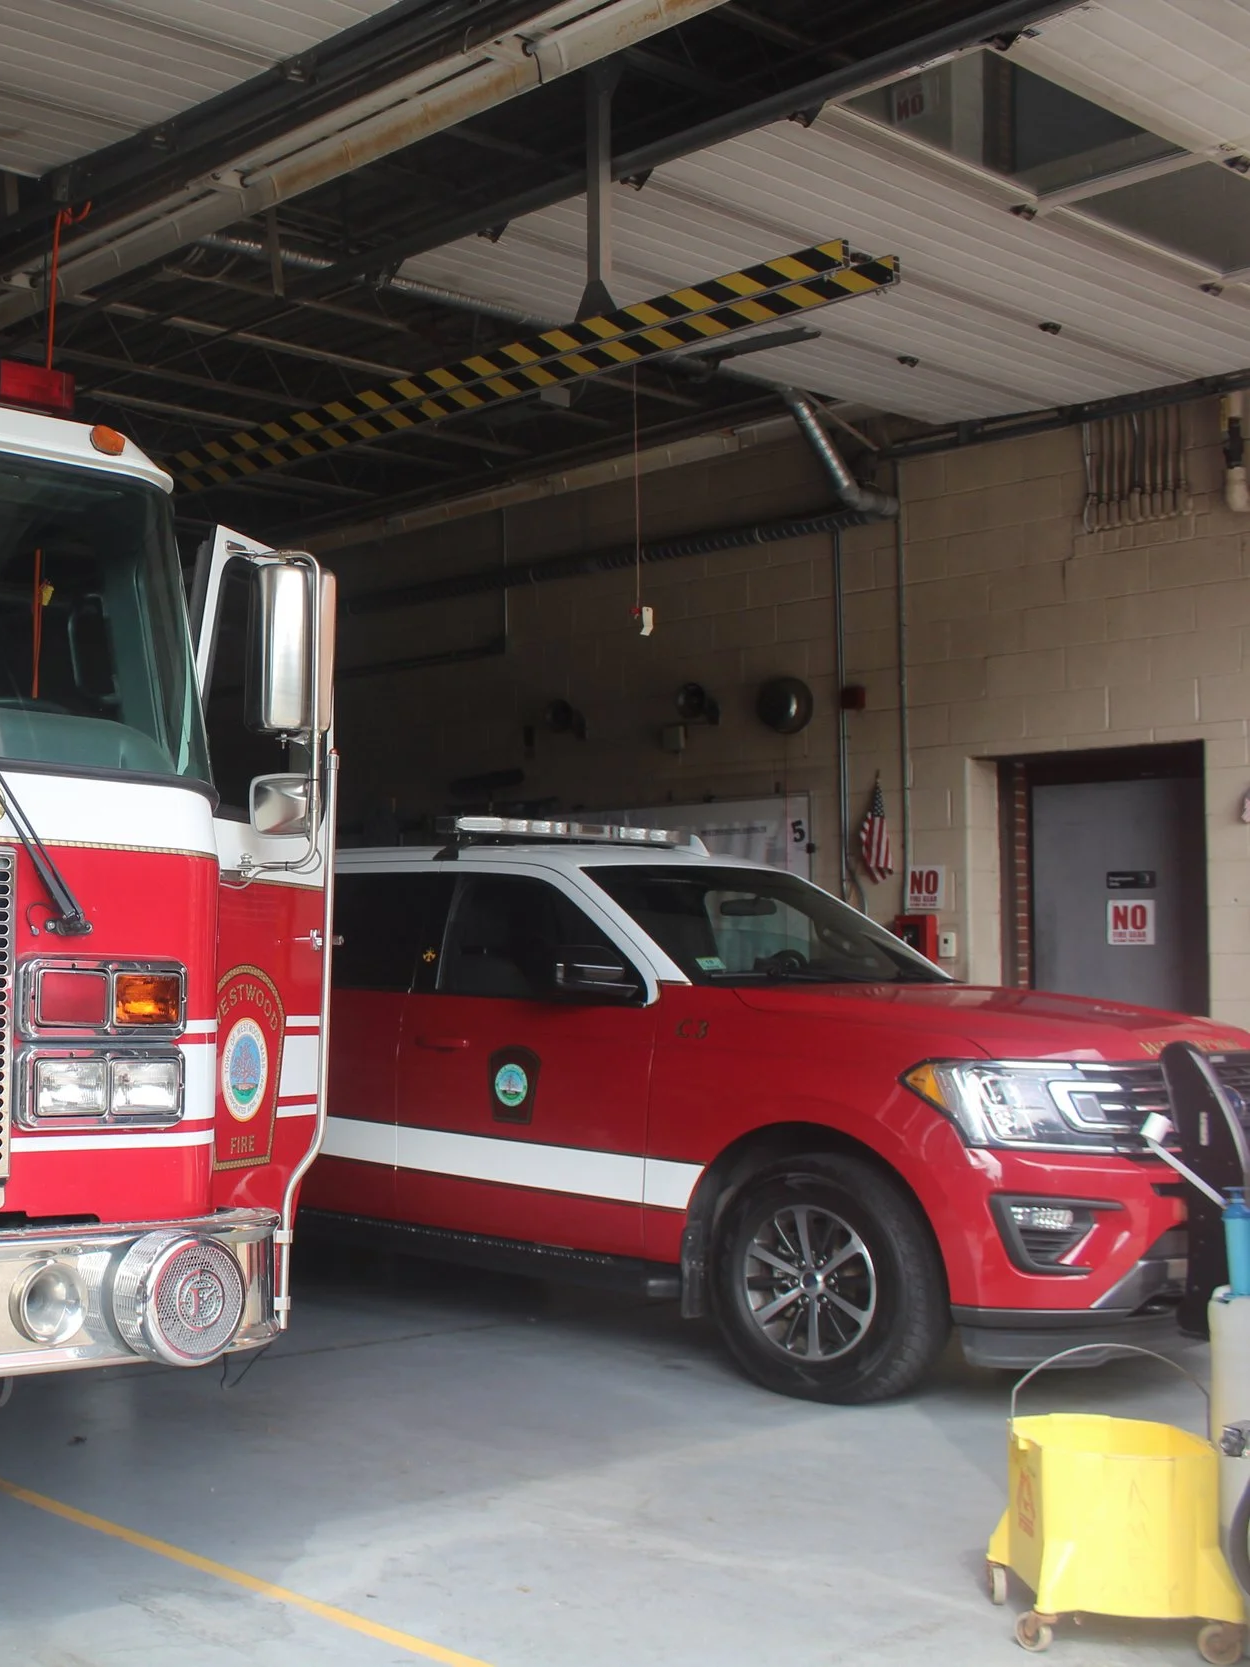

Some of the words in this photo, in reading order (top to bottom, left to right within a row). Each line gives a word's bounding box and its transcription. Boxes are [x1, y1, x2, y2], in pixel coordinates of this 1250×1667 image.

[791, 820, 806, 843] 5
[910, 870, 939, 895] NO
[1113, 904, 1147, 930] NO
[230, 1134, 255, 1155] FIRE
